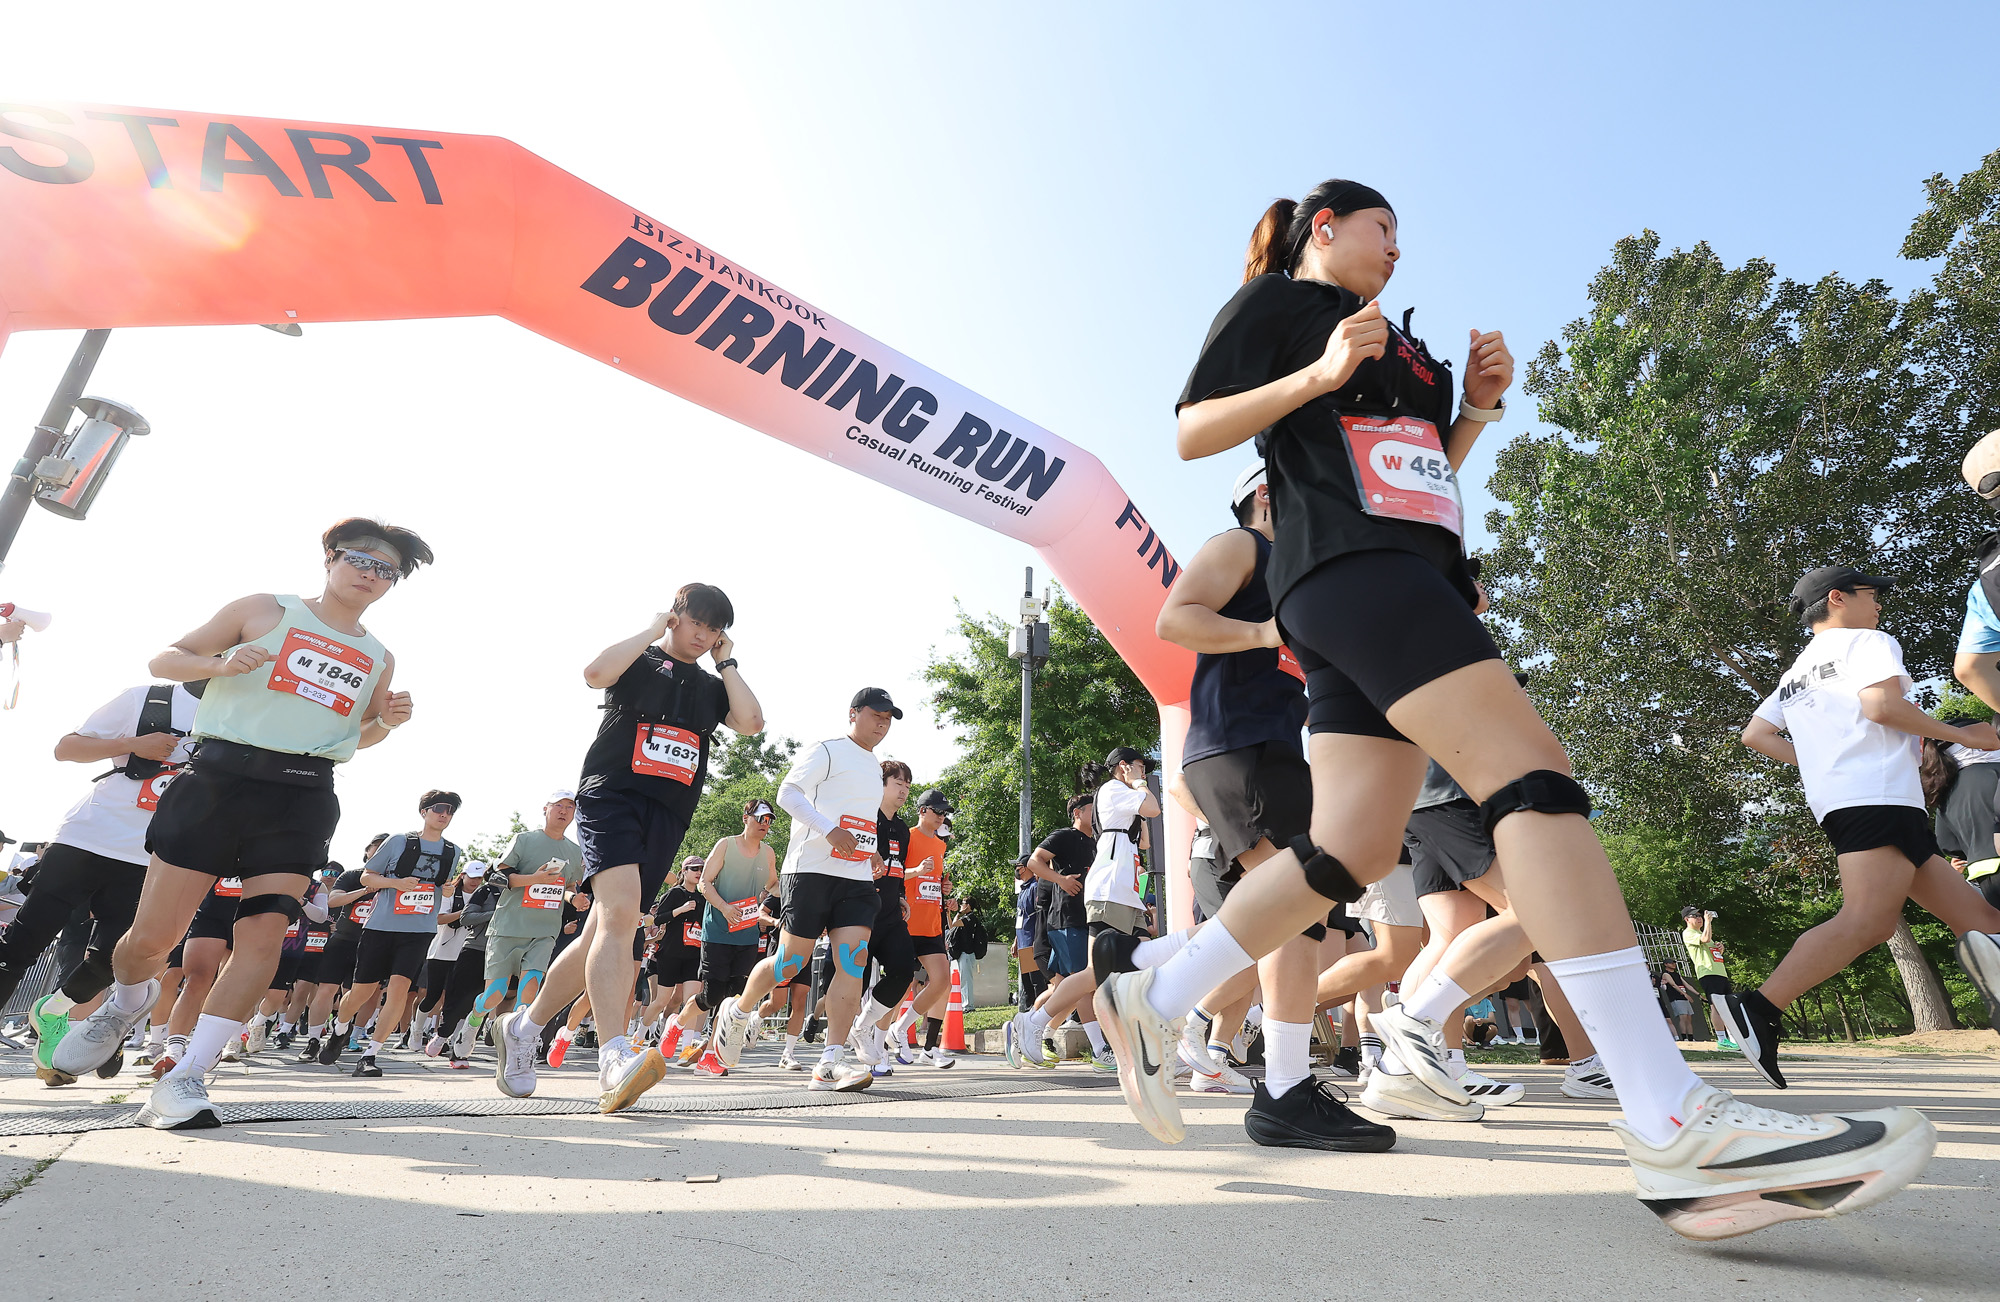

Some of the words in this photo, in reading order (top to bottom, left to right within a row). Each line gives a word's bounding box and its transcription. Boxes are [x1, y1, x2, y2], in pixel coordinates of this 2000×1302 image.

[0, 102, 443, 206] START
[580, 236, 938, 444] BURNING
[932, 411, 1065, 502] RUN
[1352, 423, 1402, 433] BURNING
[1404, 424, 1424, 437] RUN
[845, 425, 906, 462] Casual
[906, 452, 974, 494] Running
[974, 483, 1032, 518] Festival
[1382, 454, 1402, 471] W
[292, 633, 327, 648] BURNING
[326, 644, 345, 654] RUN
[297, 655, 313, 669] M
[317, 661, 363, 689] 1846
[302, 686, 328, 701] B-232
[648, 742, 660, 752] M
[664, 744, 698, 762] 1637
[855, 833, 876, 846] 2547
[412, 893, 433, 901] 1507
[541, 887, 562, 895] 2266
